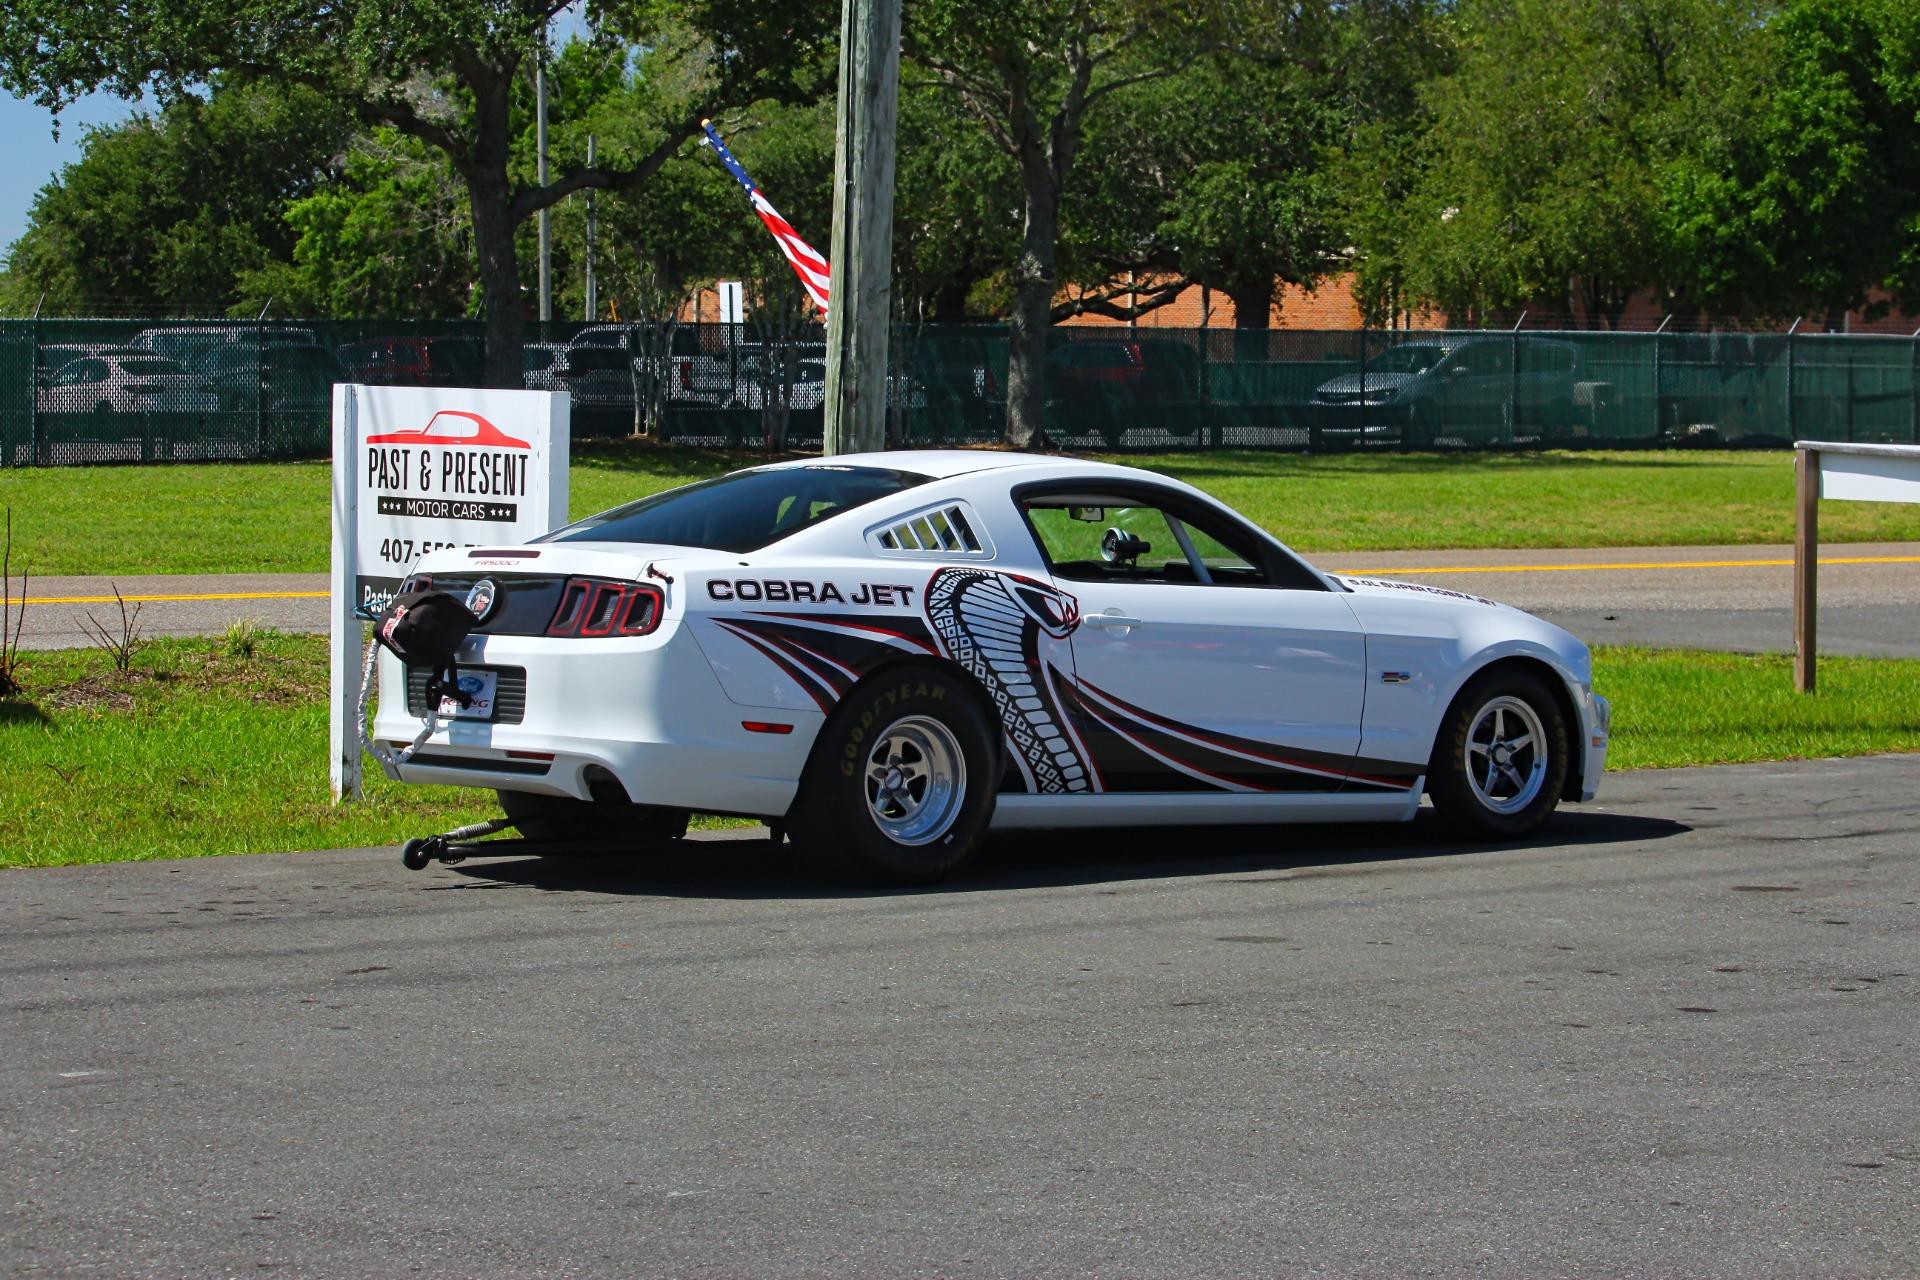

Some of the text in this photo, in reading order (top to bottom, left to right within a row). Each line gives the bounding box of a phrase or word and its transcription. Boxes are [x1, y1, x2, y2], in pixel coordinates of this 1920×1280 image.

[368, 448, 528, 496] PAST & PRESENT
[406, 500, 485, 519] MOTOR CARS
[706, 579, 915, 607] COBRA JET
[1380, 581, 1427, 593] SUPER
[1427, 587, 1475, 601] COBRA
[840, 681, 945, 777] GOODYEAR
